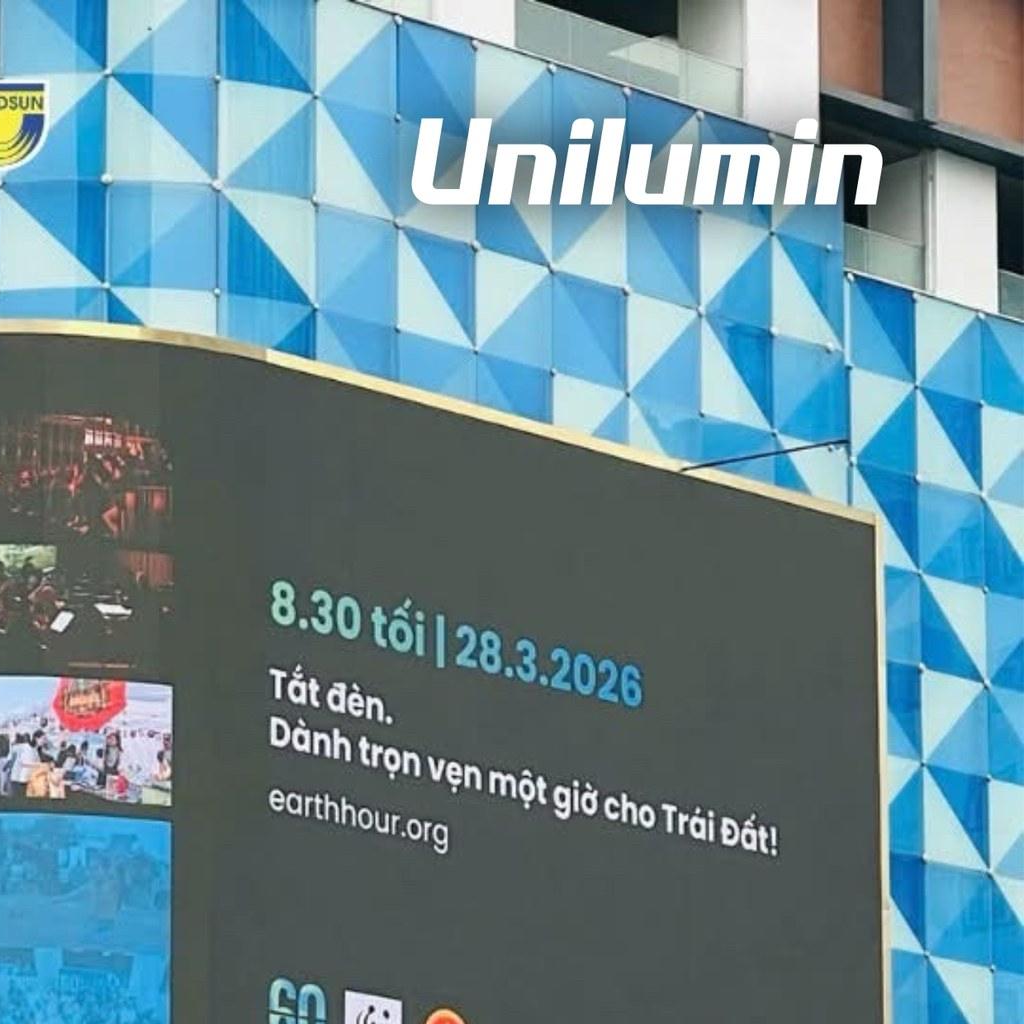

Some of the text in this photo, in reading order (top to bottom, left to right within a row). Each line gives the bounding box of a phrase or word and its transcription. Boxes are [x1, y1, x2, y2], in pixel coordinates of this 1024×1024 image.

[270, 580, 361, 640] 8.30
[371, 597, 425, 657] tối
[455, 624, 643, 707] 28.3.2026
[269, 663, 393, 725] Tắt đèn.
[269, 788, 449, 855] earthhour.org
[270, 716, 778, 857] Dành trọn vẹn một giờ cho Trái Đất!
